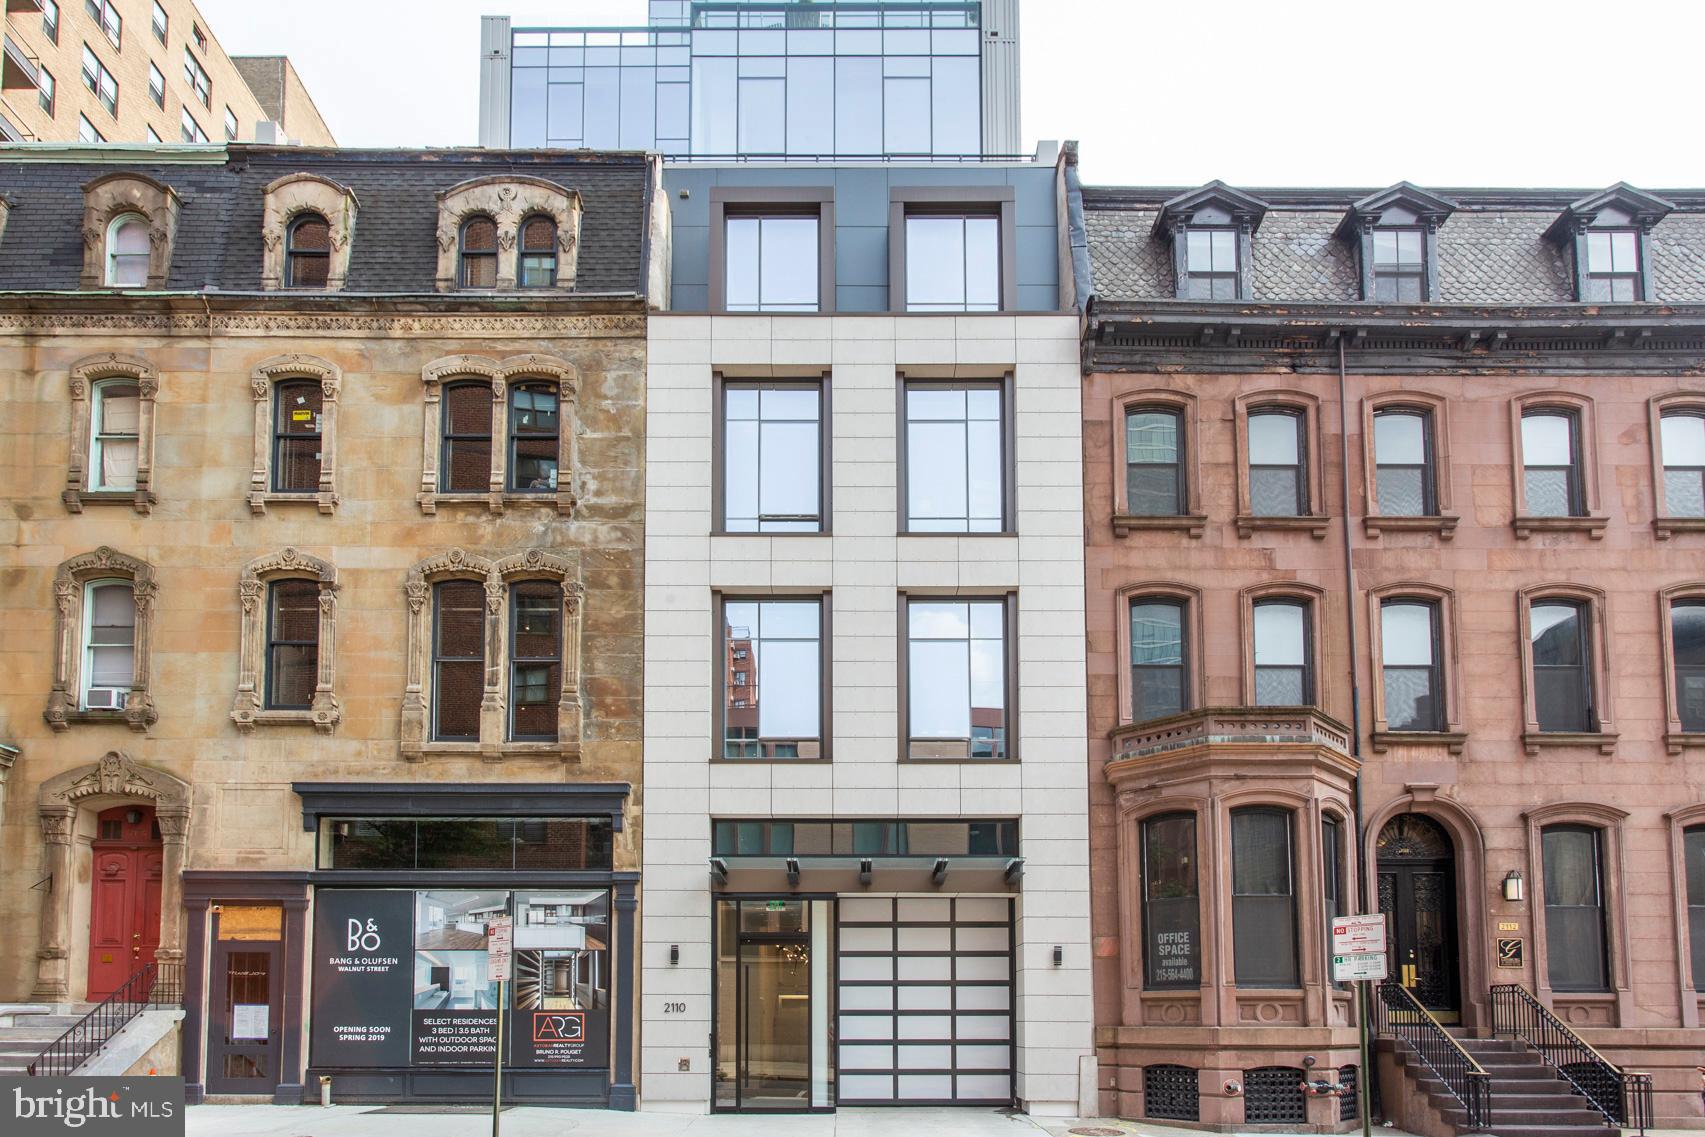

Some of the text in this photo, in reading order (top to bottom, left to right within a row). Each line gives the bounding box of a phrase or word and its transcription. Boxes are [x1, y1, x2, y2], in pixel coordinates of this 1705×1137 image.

[1158, 932, 1190, 944] OFFICE
[1159, 944, 1190, 956] SPACE
[329, 957, 352, 965] BANG
[361, 957, 398, 965] OLUFSEN
[1162, 956, 1187, 966] available
[664, 1002, 686, 1013] 2110
[538, 1016, 581, 1038] ARG
